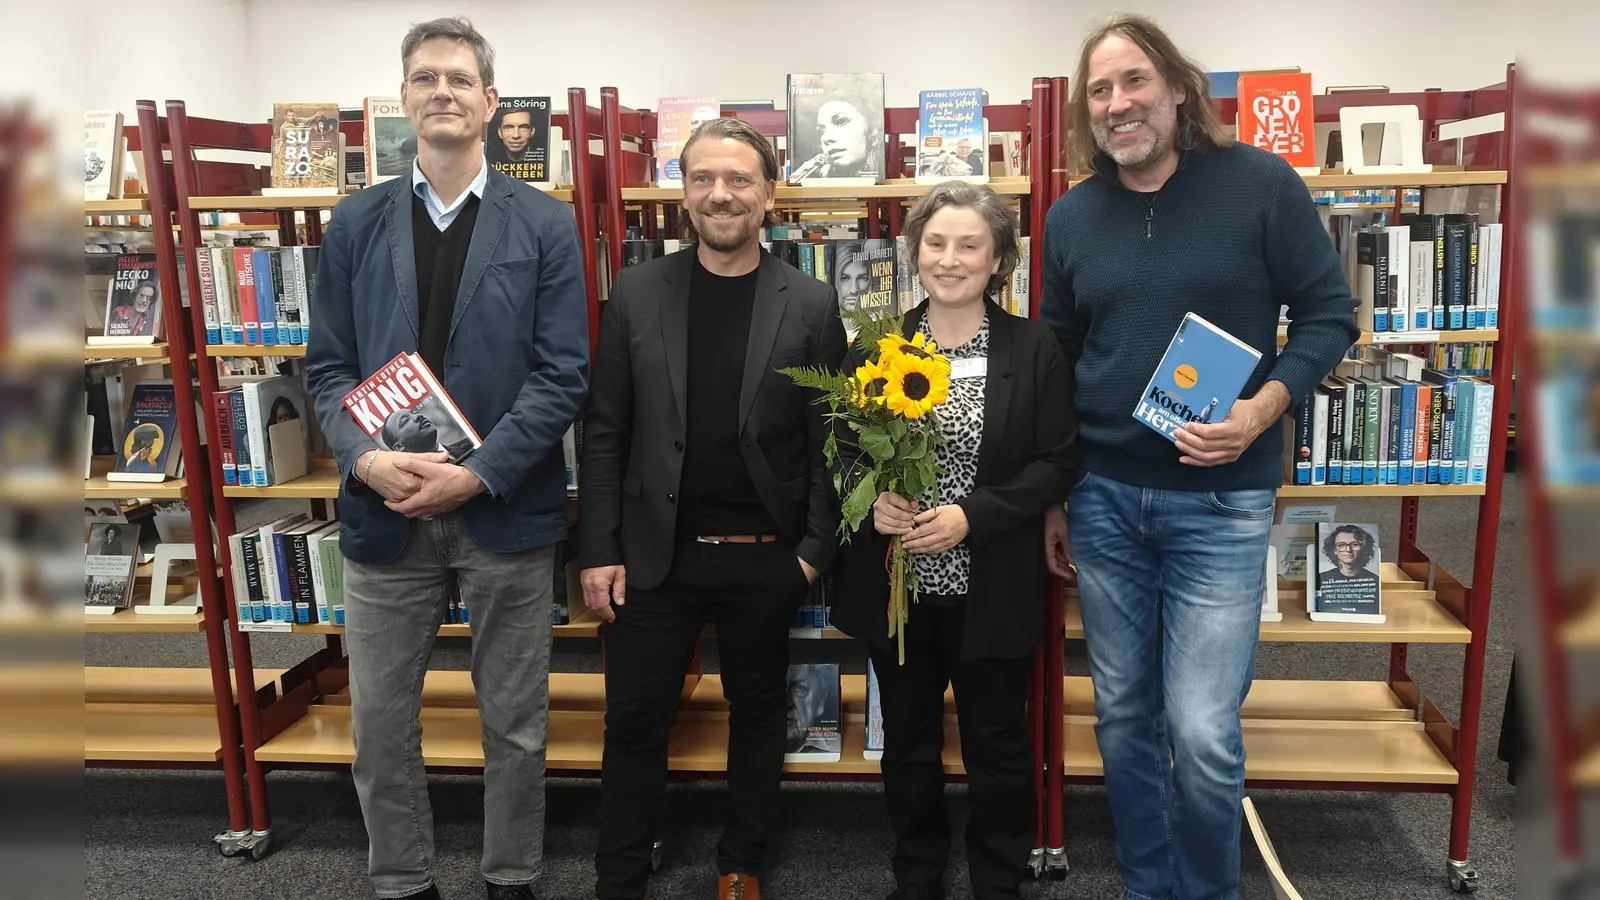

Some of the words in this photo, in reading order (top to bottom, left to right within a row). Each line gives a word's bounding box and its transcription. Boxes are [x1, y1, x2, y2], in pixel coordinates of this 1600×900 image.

[513, 99, 546, 110] Söring
[285, 129, 310, 143] SU
[285, 146, 311, 160] RA
[284, 161, 312, 176] ZO
[490, 161, 544, 171] ÜCKKEHR
[510, 170, 544, 179] LEBEN
[199, 250, 211, 278] SONJA
[852, 251, 869, 263] DAVID
[869, 247, 893, 260] GARRETT
[116, 269, 149, 281] LECKO
[238, 270, 247, 286] RUDI
[243, 253, 254, 286] DUTSCHKE
[871, 260, 893, 278] WENN
[115, 280, 135, 291] MIO
[202, 278, 215, 306] AGENT
[879, 275, 893, 291] IHR
[1453, 281, 1461, 305] EPHEN
[859, 290, 893, 309] WÜSSTET
[345, 381, 377, 407] MARTIN
[375, 357, 406, 384] LUTHER
[135, 401, 173, 409] SPARTACUS
[350, 366, 428, 435] KING
[1368, 388, 1379, 425] ADLON
[236, 395, 246, 431] GOETHE
[1136, 401, 1180, 440] Herz
[1158, 408, 1171, 418] am
[1417, 409, 1425, 434] SUBOTIĆ
[1432, 391, 1442, 441] MUTPROBEN
[1472, 390, 1491, 457] EISPAPST
[217, 408, 232, 449] AUERBACH
[244, 539, 254, 561] PAUL
[264, 535, 272, 557] CHRISTIE
[267, 556, 275, 576] AGATHA
[293, 535, 309, 585] FLAMMEN
[247, 563, 258, 587] MAAR
[300, 588, 310, 598] IN
